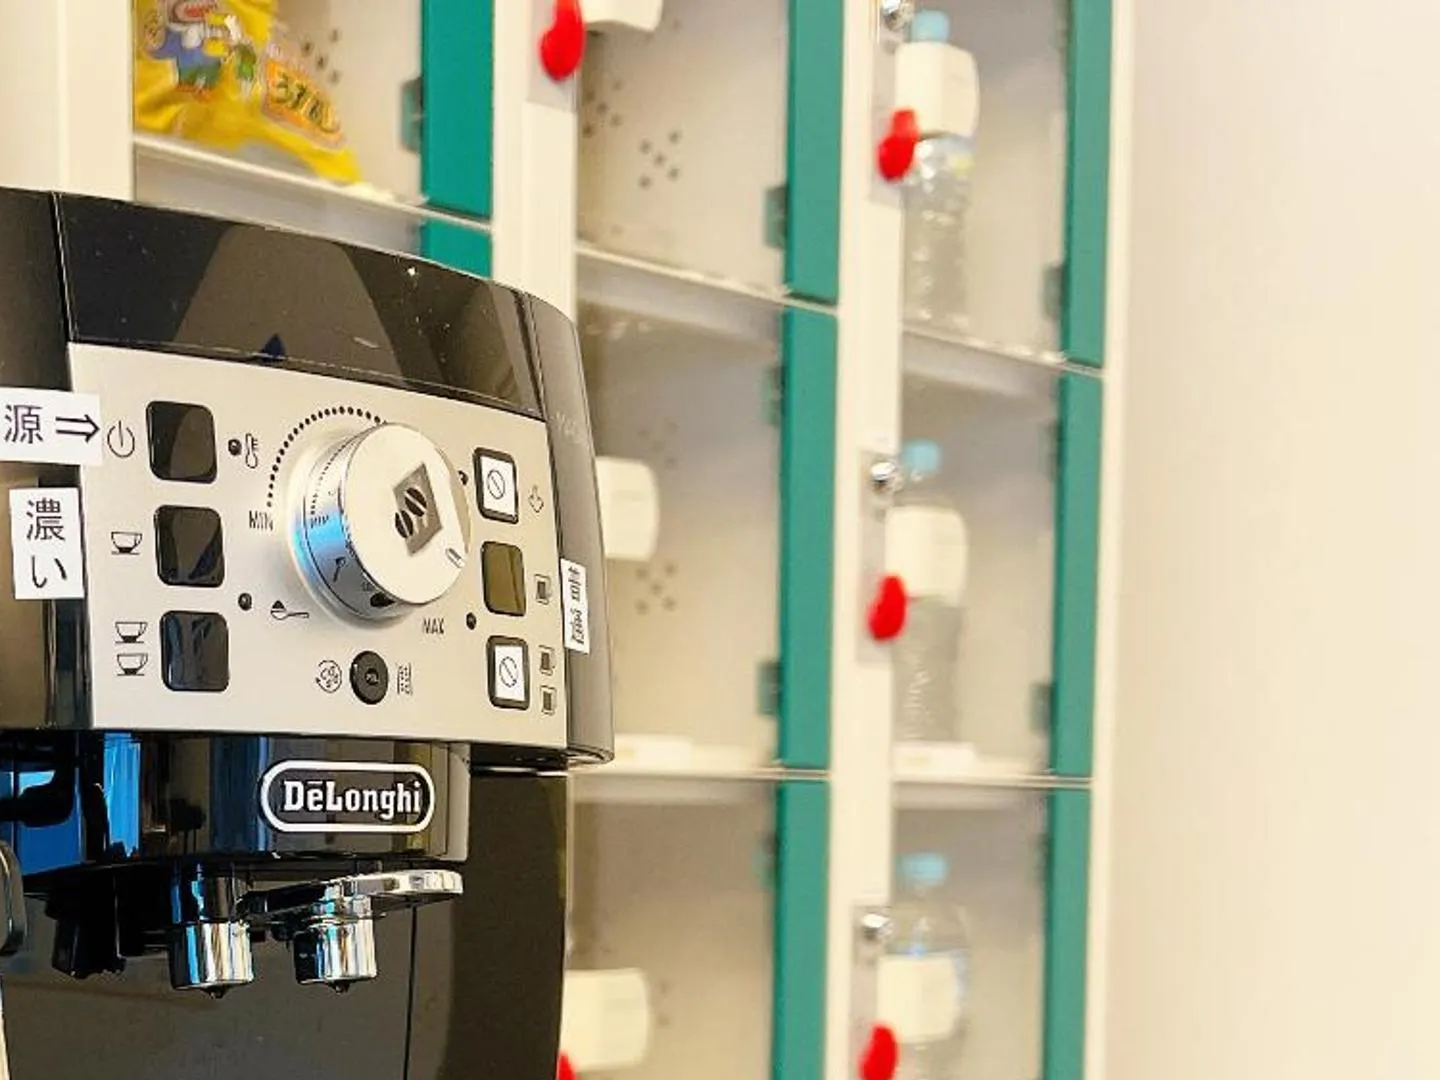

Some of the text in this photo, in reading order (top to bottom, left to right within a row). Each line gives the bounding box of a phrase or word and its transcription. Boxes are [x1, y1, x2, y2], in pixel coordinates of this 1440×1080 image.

[248, 510, 274, 531] MIN
[26, 496, 67, 588] 濃い
[422, 618, 445, 635] MAX
